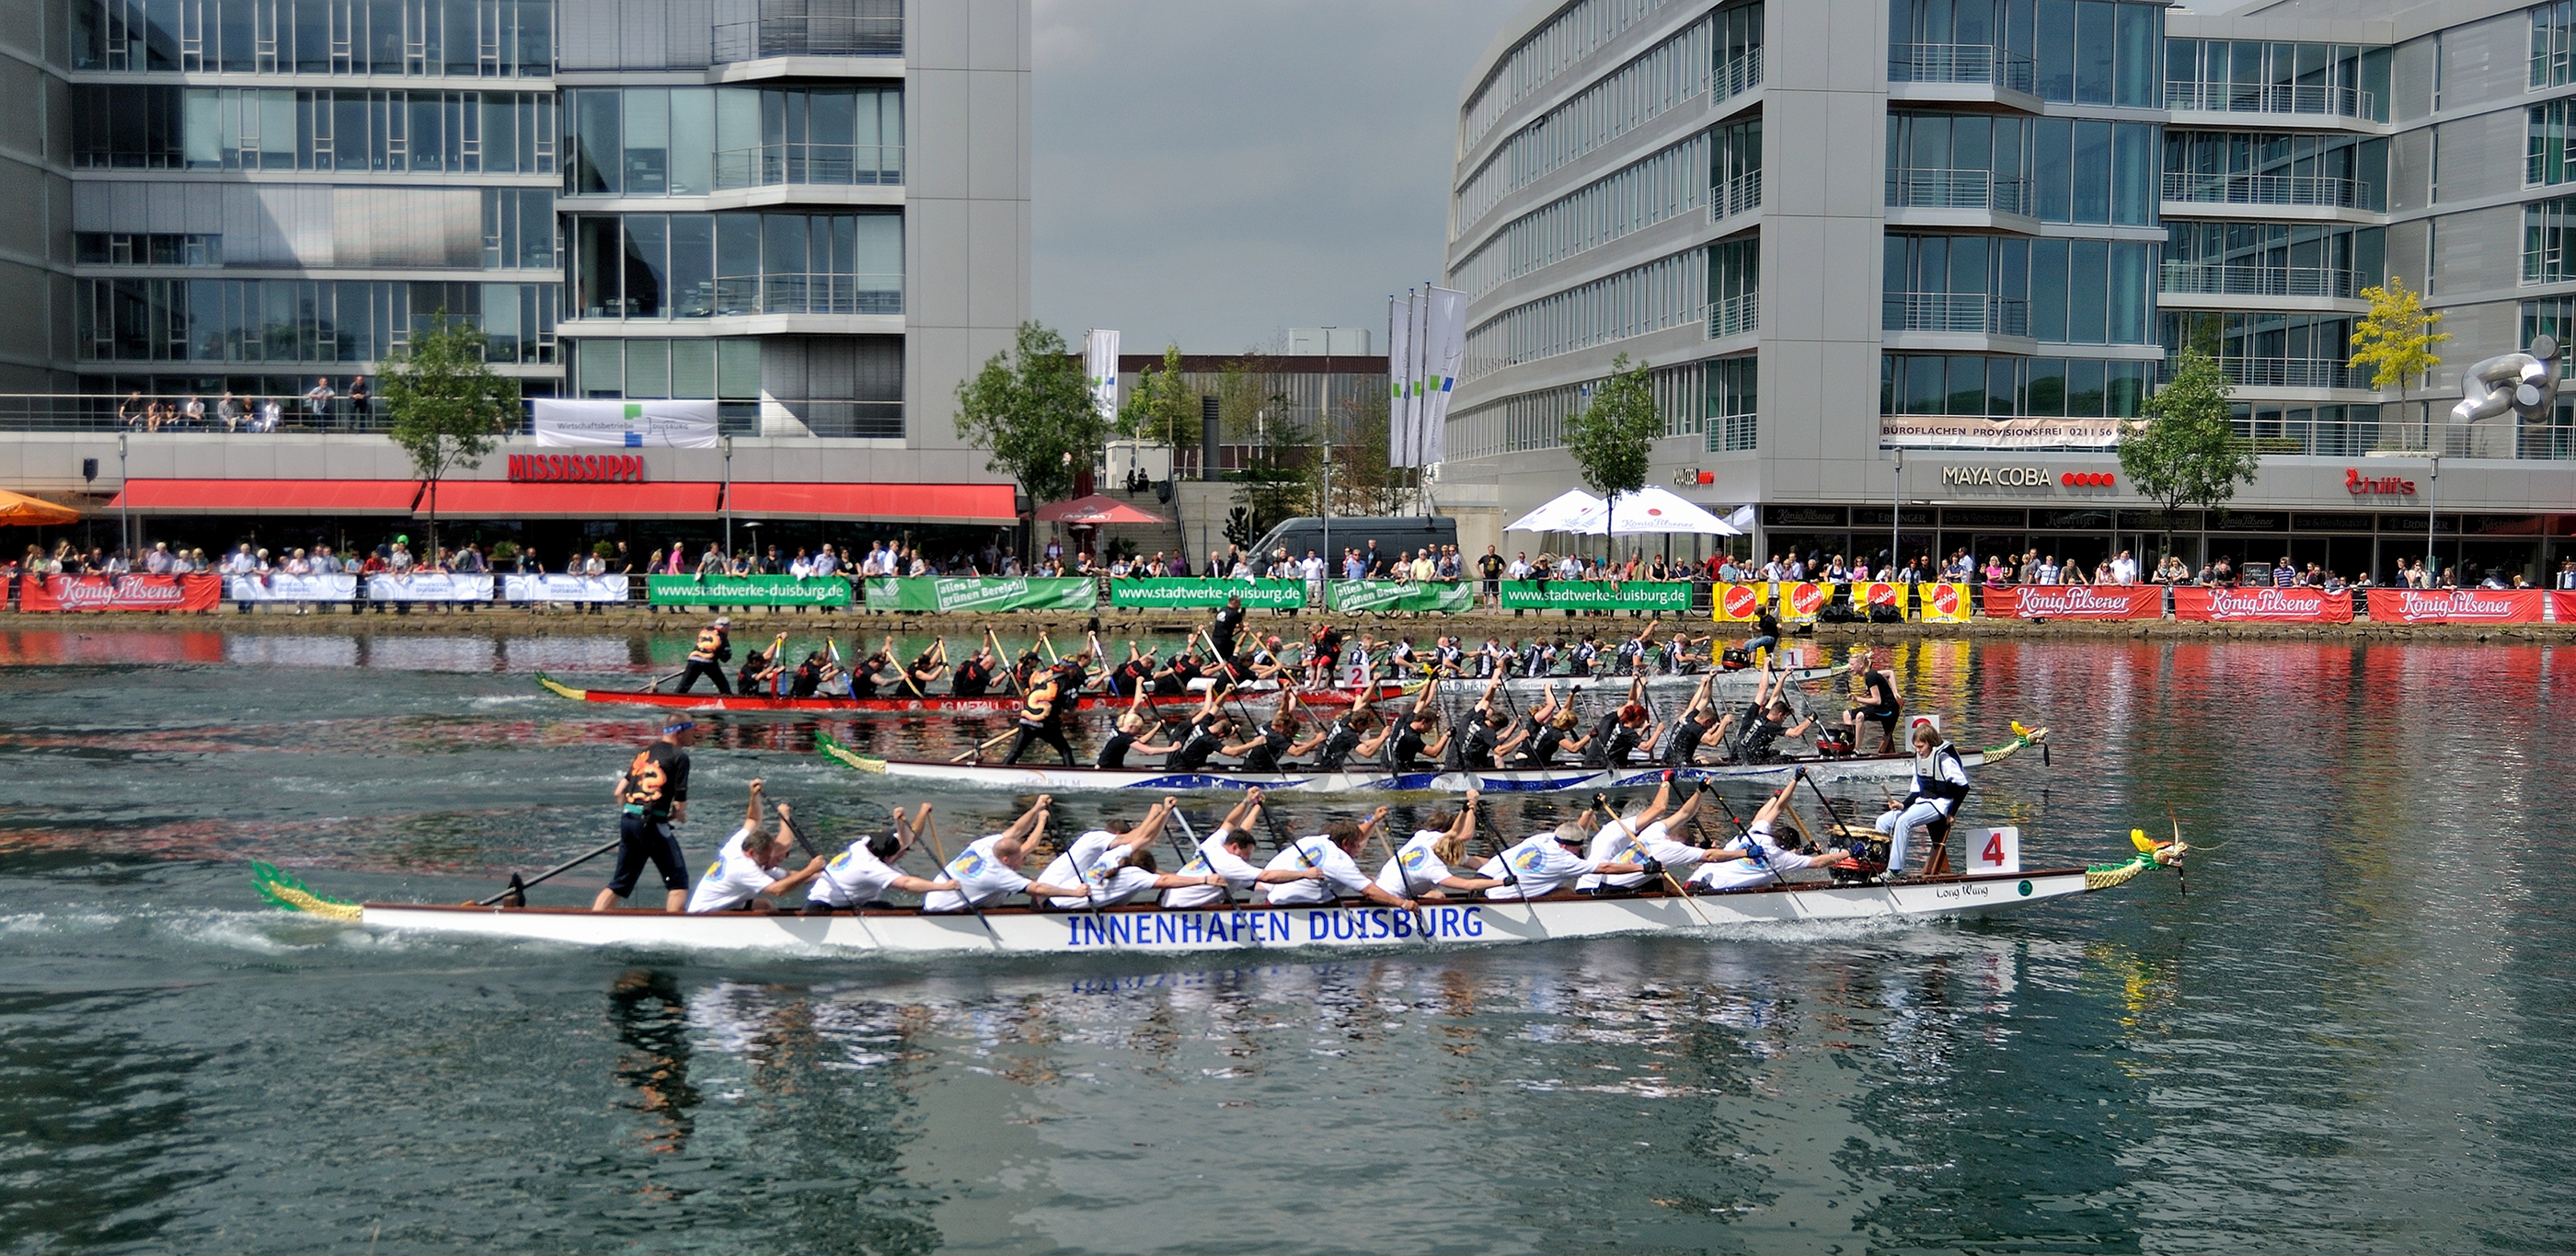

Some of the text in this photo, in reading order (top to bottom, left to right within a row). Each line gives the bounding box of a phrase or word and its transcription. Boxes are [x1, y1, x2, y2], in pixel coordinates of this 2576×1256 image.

[557, 421, 635, 431] Wirtschaftsbetriebe
[1883, 425, 1966, 435] BÜROFLÄCHEN
[1972, 427, 2062, 437] PROVISIONSFREI
[2070, 428, 2094, 436] 0211
[2099, 428, 2112, 436] 56
[508, 454, 643, 480] MISSISSIPPI
[1942, 467, 2053, 487] MAYA COBA
[2348, 477, 2416, 494] chili's
[1622, 518, 1695, 528] König Pilsener
[2243, 513, 2274, 526] Pilsener
[57, 576, 114, 605] König
[657, 583, 845, 600] www.stadtwerke-duisburg.de
[940, 579, 982, 594] alles im
[942, 580, 1023, 607] grünen Bereich!
[1118, 586, 1301, 603] www.stadtwerke-duisburg.de
[1338, 581, 1376, 597] alles im
[1341, 593, 1375, 608] grünen
[1508, 589, 1685, 604] www.stadtwerke-duisburg.de
[1726, 593, 1754, 613] Sinalco
[1794, 589, 1822, 609] Sinalco
[2016, 587, 2129, 614] König Pilsener
[2206, 589, 2321, 615] König Pilsener
[2398, 591, 2512, 616] König Pilsener
[1787, 651, 1798, 666] 1
[1351, 668, 1363, 685] 2
[1982, 832, 2006, 867] 4
[1936, 883, 1989, 900] Long Wang
[1068, 907, 1483, 946] INNENHAFEN DUISBURG
